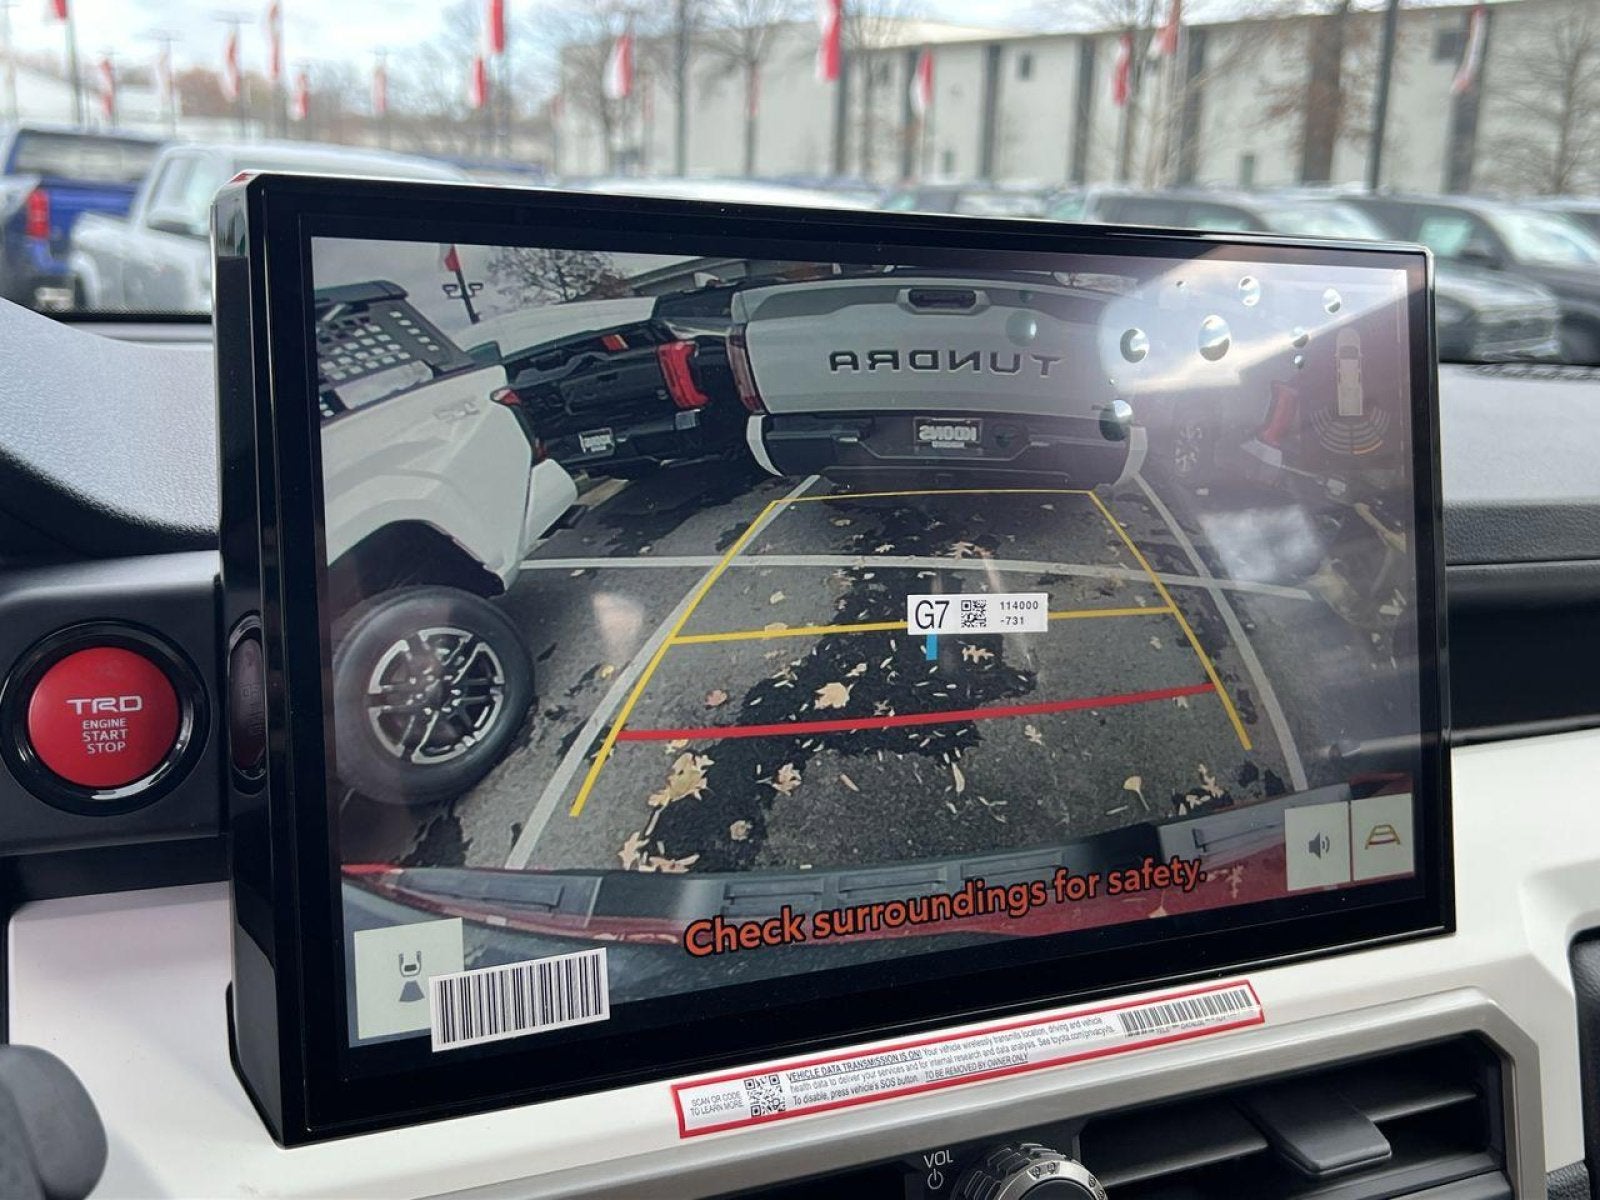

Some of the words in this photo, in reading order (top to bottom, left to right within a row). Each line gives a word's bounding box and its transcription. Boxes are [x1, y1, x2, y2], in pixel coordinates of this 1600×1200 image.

[915, 600, 949, 629] G7
[1000, 601, 1039, 610] 114000
[1000, 616, 1024, 626] -731
[66, 695, 143, 715] TRD
[82, 718, 126, 730] ENGINE
[82, 729, 128, 742] START
[87, 741, 126, 754] STOP
[683, 905, 805, 958] Check
[812, 873, 1047, 939] surroundings
[1052, 867, 1101, 903] for
[1107, 855, 1208, 896] safety.
[786, 1068, 821, 1082] VEHICLE
[820, 1064, 840, 1075] DATA
[841, 1054, 899, 1072] TRANSMISSION
[898, 1052, 907, 1061] IS
[922, 1046, 937, 1056] Your
[938, 1043, 961, 1053] vehicle
[962, 1037, 992, 1049] wirelessly
[992, 1032, 1021, 1043] transmits
[1048, 1022, 1068, 1032] driving
[1068, 1020, 1081, 1028] and
[1081, 1017, 1102, 1026] vehicle
[789, 1082, 812, 1093] health
[812, 1078, 828, 1089] data
[829, 1076, 837, 1085] to
[837, 1073, 860, 1084] deliver
[861, 1070, 877, 1082] your
[877, 1065, 904, 1076] services
[905, 1061, 918, 1071] and
[918, 1059, 928, 1068] for
[929, 1056, 952, 1066] internal
[953, 1050, 981, 1062] research
[981, 1047, 995, 1056] and
[995, 1044, 1009, 1054] data
[1037, 1037, 1050, 1046] See
[792, 1095, 801, 1104] To
[829, 1087, 849, 1099] press
[849, 1081, 879, 1093] vehicle's
[879, 1078, 896, 1088] SOS
[924, 1071, 933, 1079] TO
[934, 1069, 944, 1077] BE
[944, 1063, 976, 1075] REMOVED
[977, 1061, 985, 1069] BY
[986, 1056, 1011, 1067] OWNER
[1011, 1052, 1028, 1062] ONLY
[690, 1107, 701, 1116] TO
[700, 1104, 723, 1114] LEARN
[723, 1099, 743, 1109] MORE
[691, 1097, 710, 1107] SCAN
[721, 1090, 741, 1101] CODE
[923, 1149, 953, 1168] VOL
